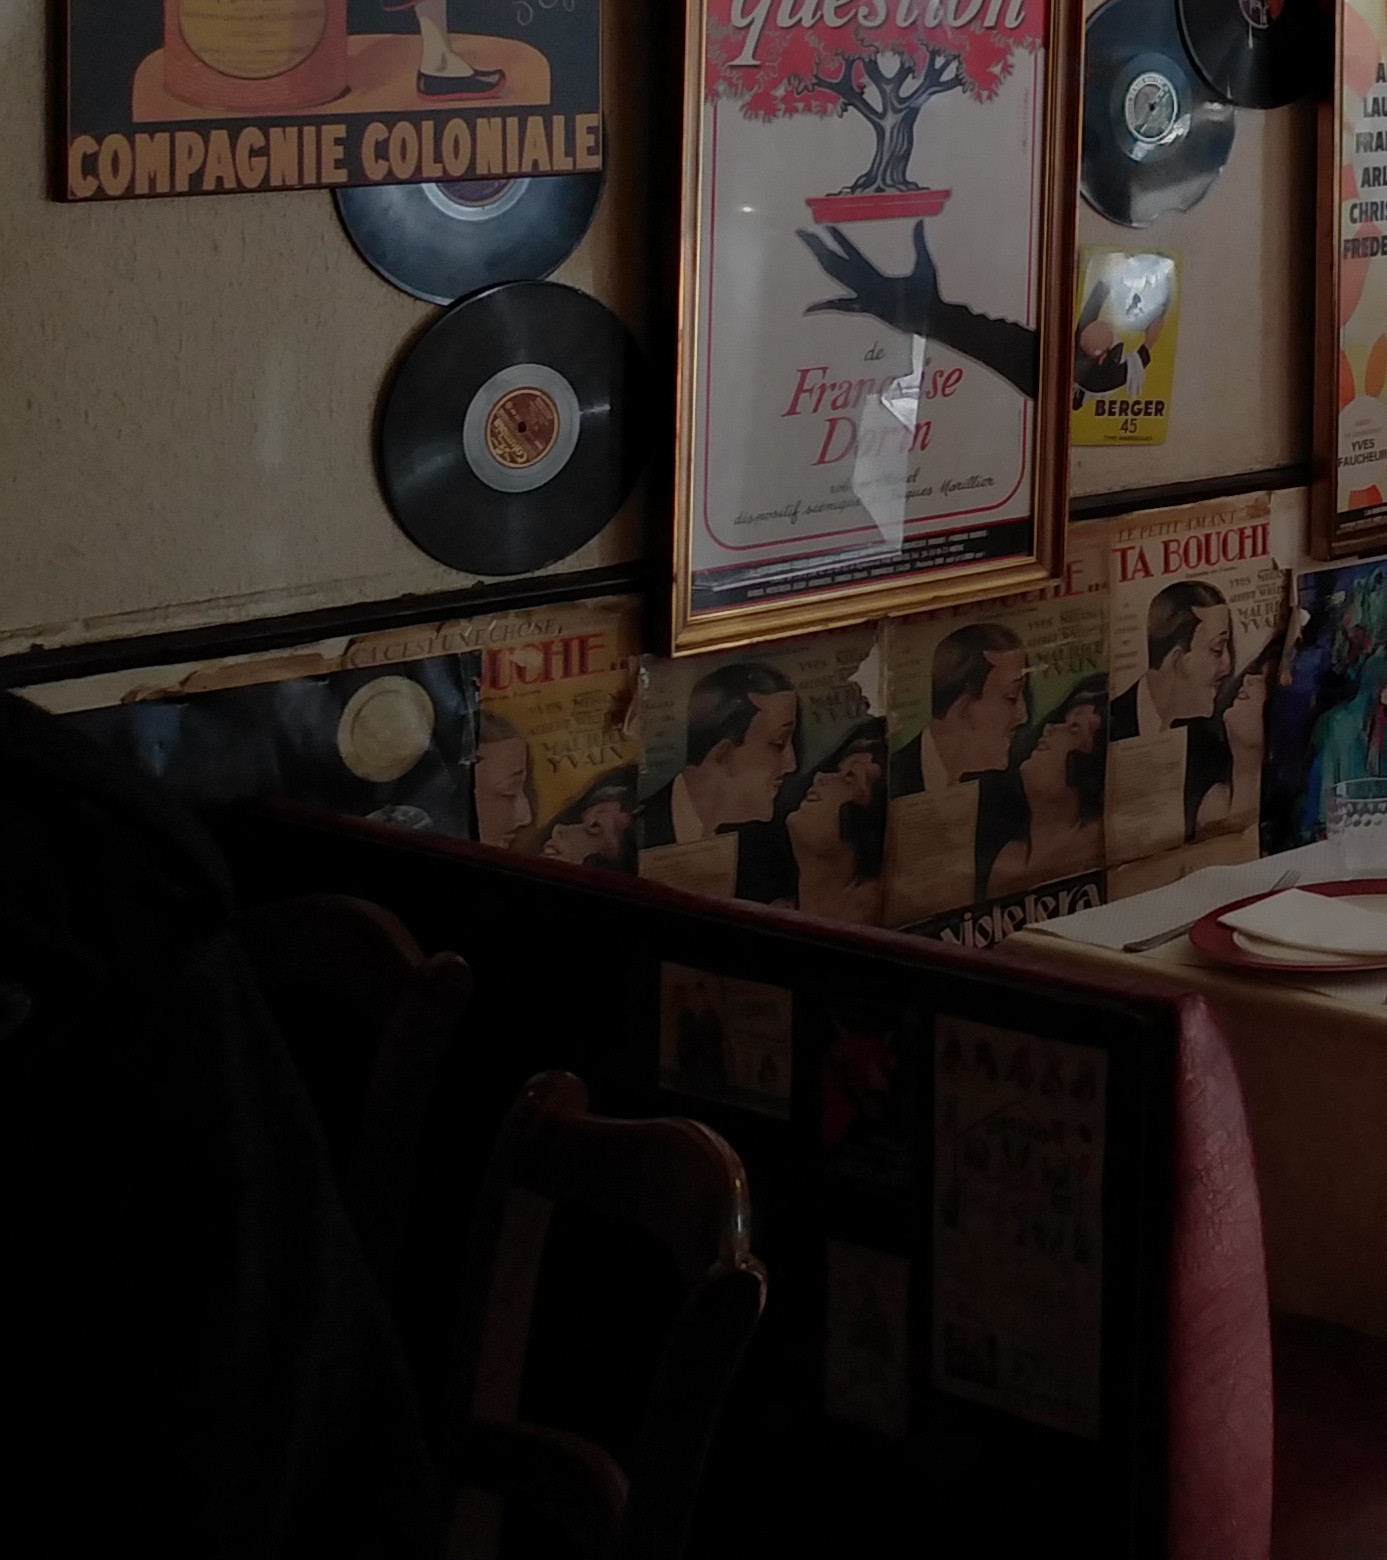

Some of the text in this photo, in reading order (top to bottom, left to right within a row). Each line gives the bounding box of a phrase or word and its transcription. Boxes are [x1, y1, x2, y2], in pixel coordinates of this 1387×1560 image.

[69, 113, 602, 199] COMPAGNIE COLONIALE
[864, 341, 885, 361] de
[781, 357, 963, 417] Franse
[1094, 400, 1165, 417] BERGER
[1120, 419, 1138, 434] 45
[811, 417, 932, 466] Dorn
[1351, 439, 1375, 452] YVES
[1112, 545, 1154, 583] TA
